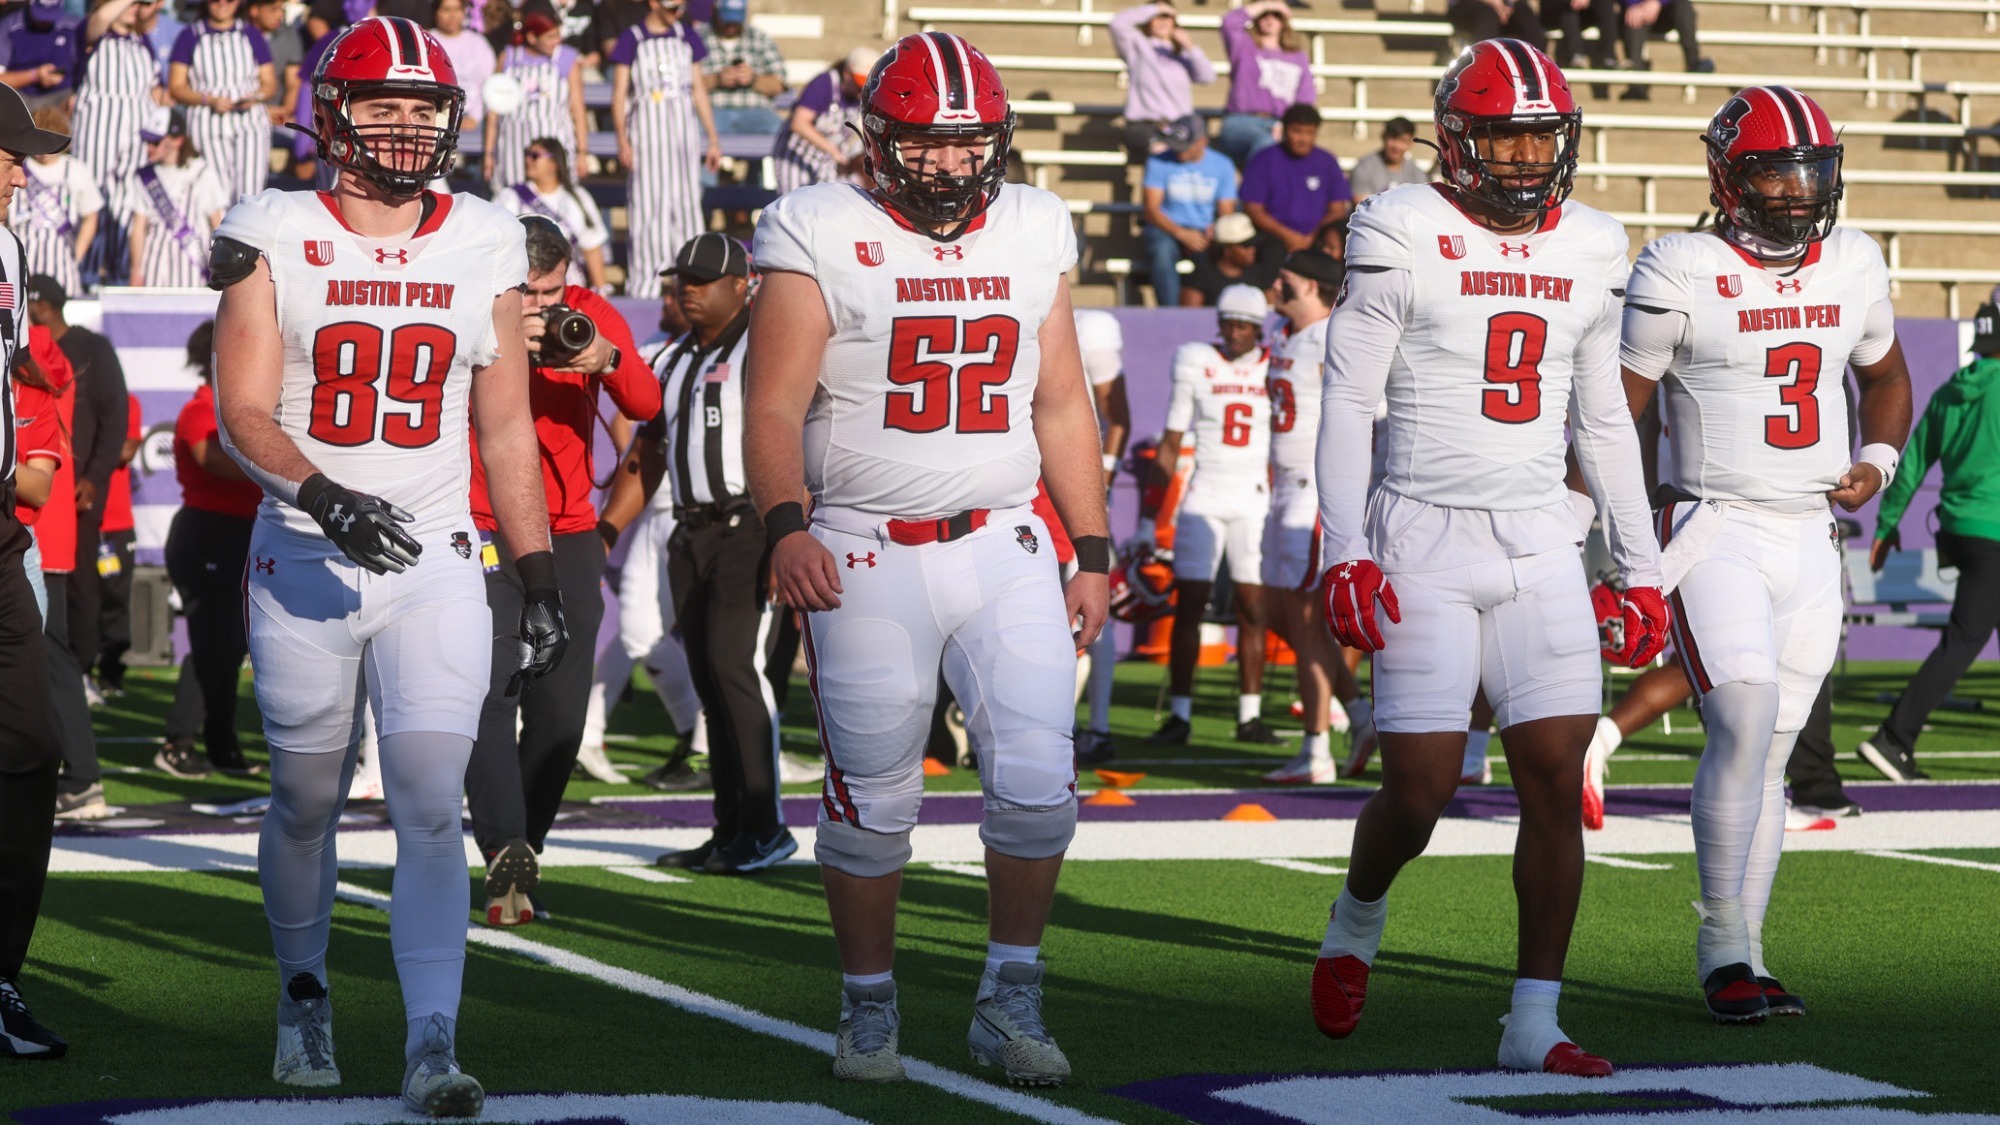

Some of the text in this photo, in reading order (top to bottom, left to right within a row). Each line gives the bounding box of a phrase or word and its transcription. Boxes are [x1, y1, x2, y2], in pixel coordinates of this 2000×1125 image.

[326, 280, 455, 309] AUSTIN PEAY
[895, 276, 1011, 303] AUSTIN PEAY
[1461, 271, 1574, 302] AUSTIN PEAY
[1738, 304, 1841, 333] AUSTIN PEAY
[307, 321, 457, 449] 89
[883, 314, 1021, 434] 52
[1481, 311, 1548, 425] 9
[1764, 341, 1822, 450] 3
[706, 406, 721, 428] B
[1222, 402, 1253, 447] 6
